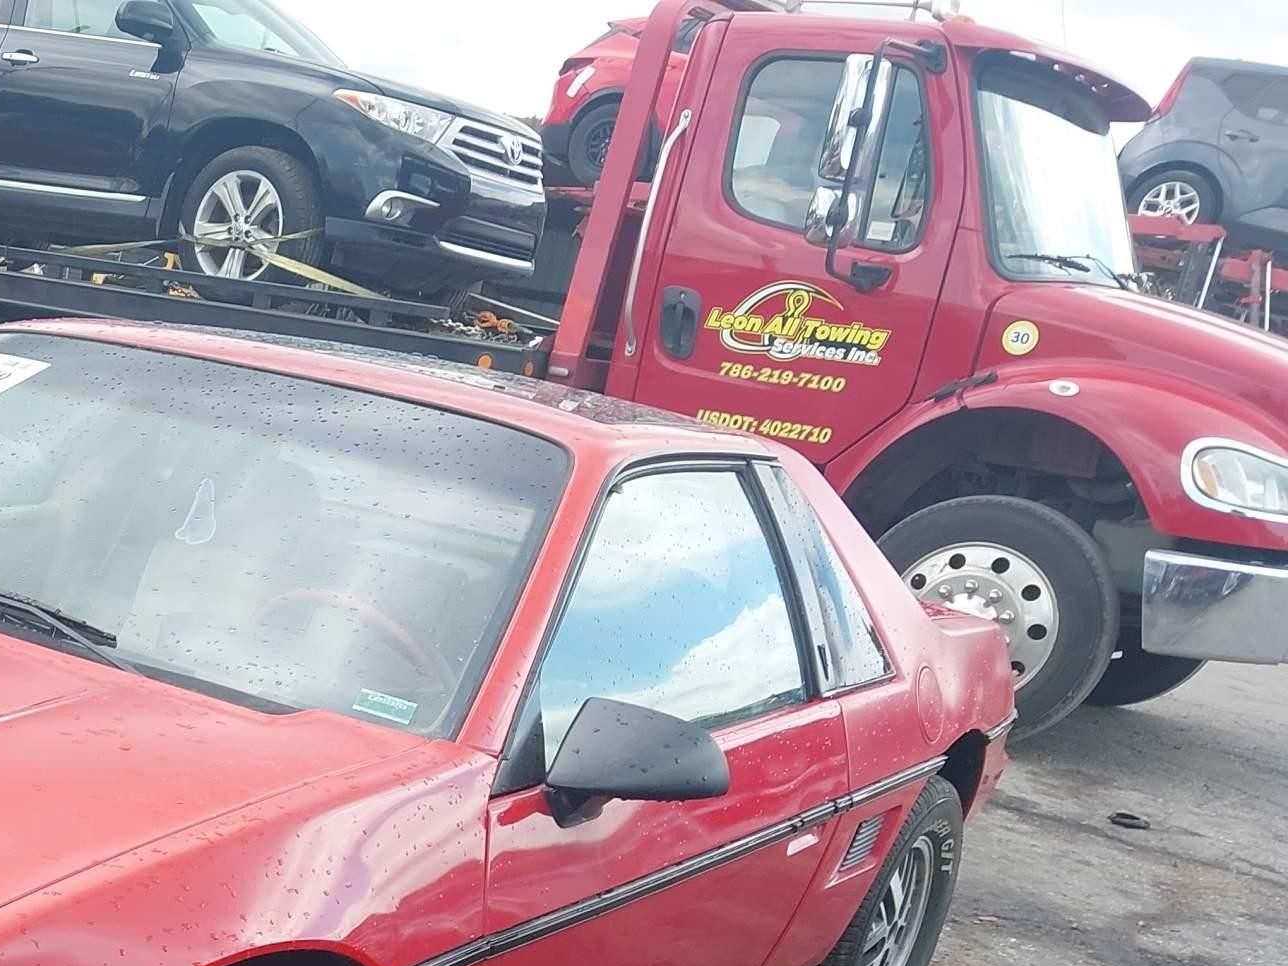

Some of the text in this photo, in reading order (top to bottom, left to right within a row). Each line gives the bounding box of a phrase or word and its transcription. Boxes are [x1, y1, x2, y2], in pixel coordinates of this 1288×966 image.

[706, 309, 889, 349] Leon All Towing
[1011, 331, 1030, 345] 30
[771, 338, 881, 364] Services Inc.
[719, 361, 846, 392] 786-219-7100
[696, 409, 832, 443] USDOT: 4022710
